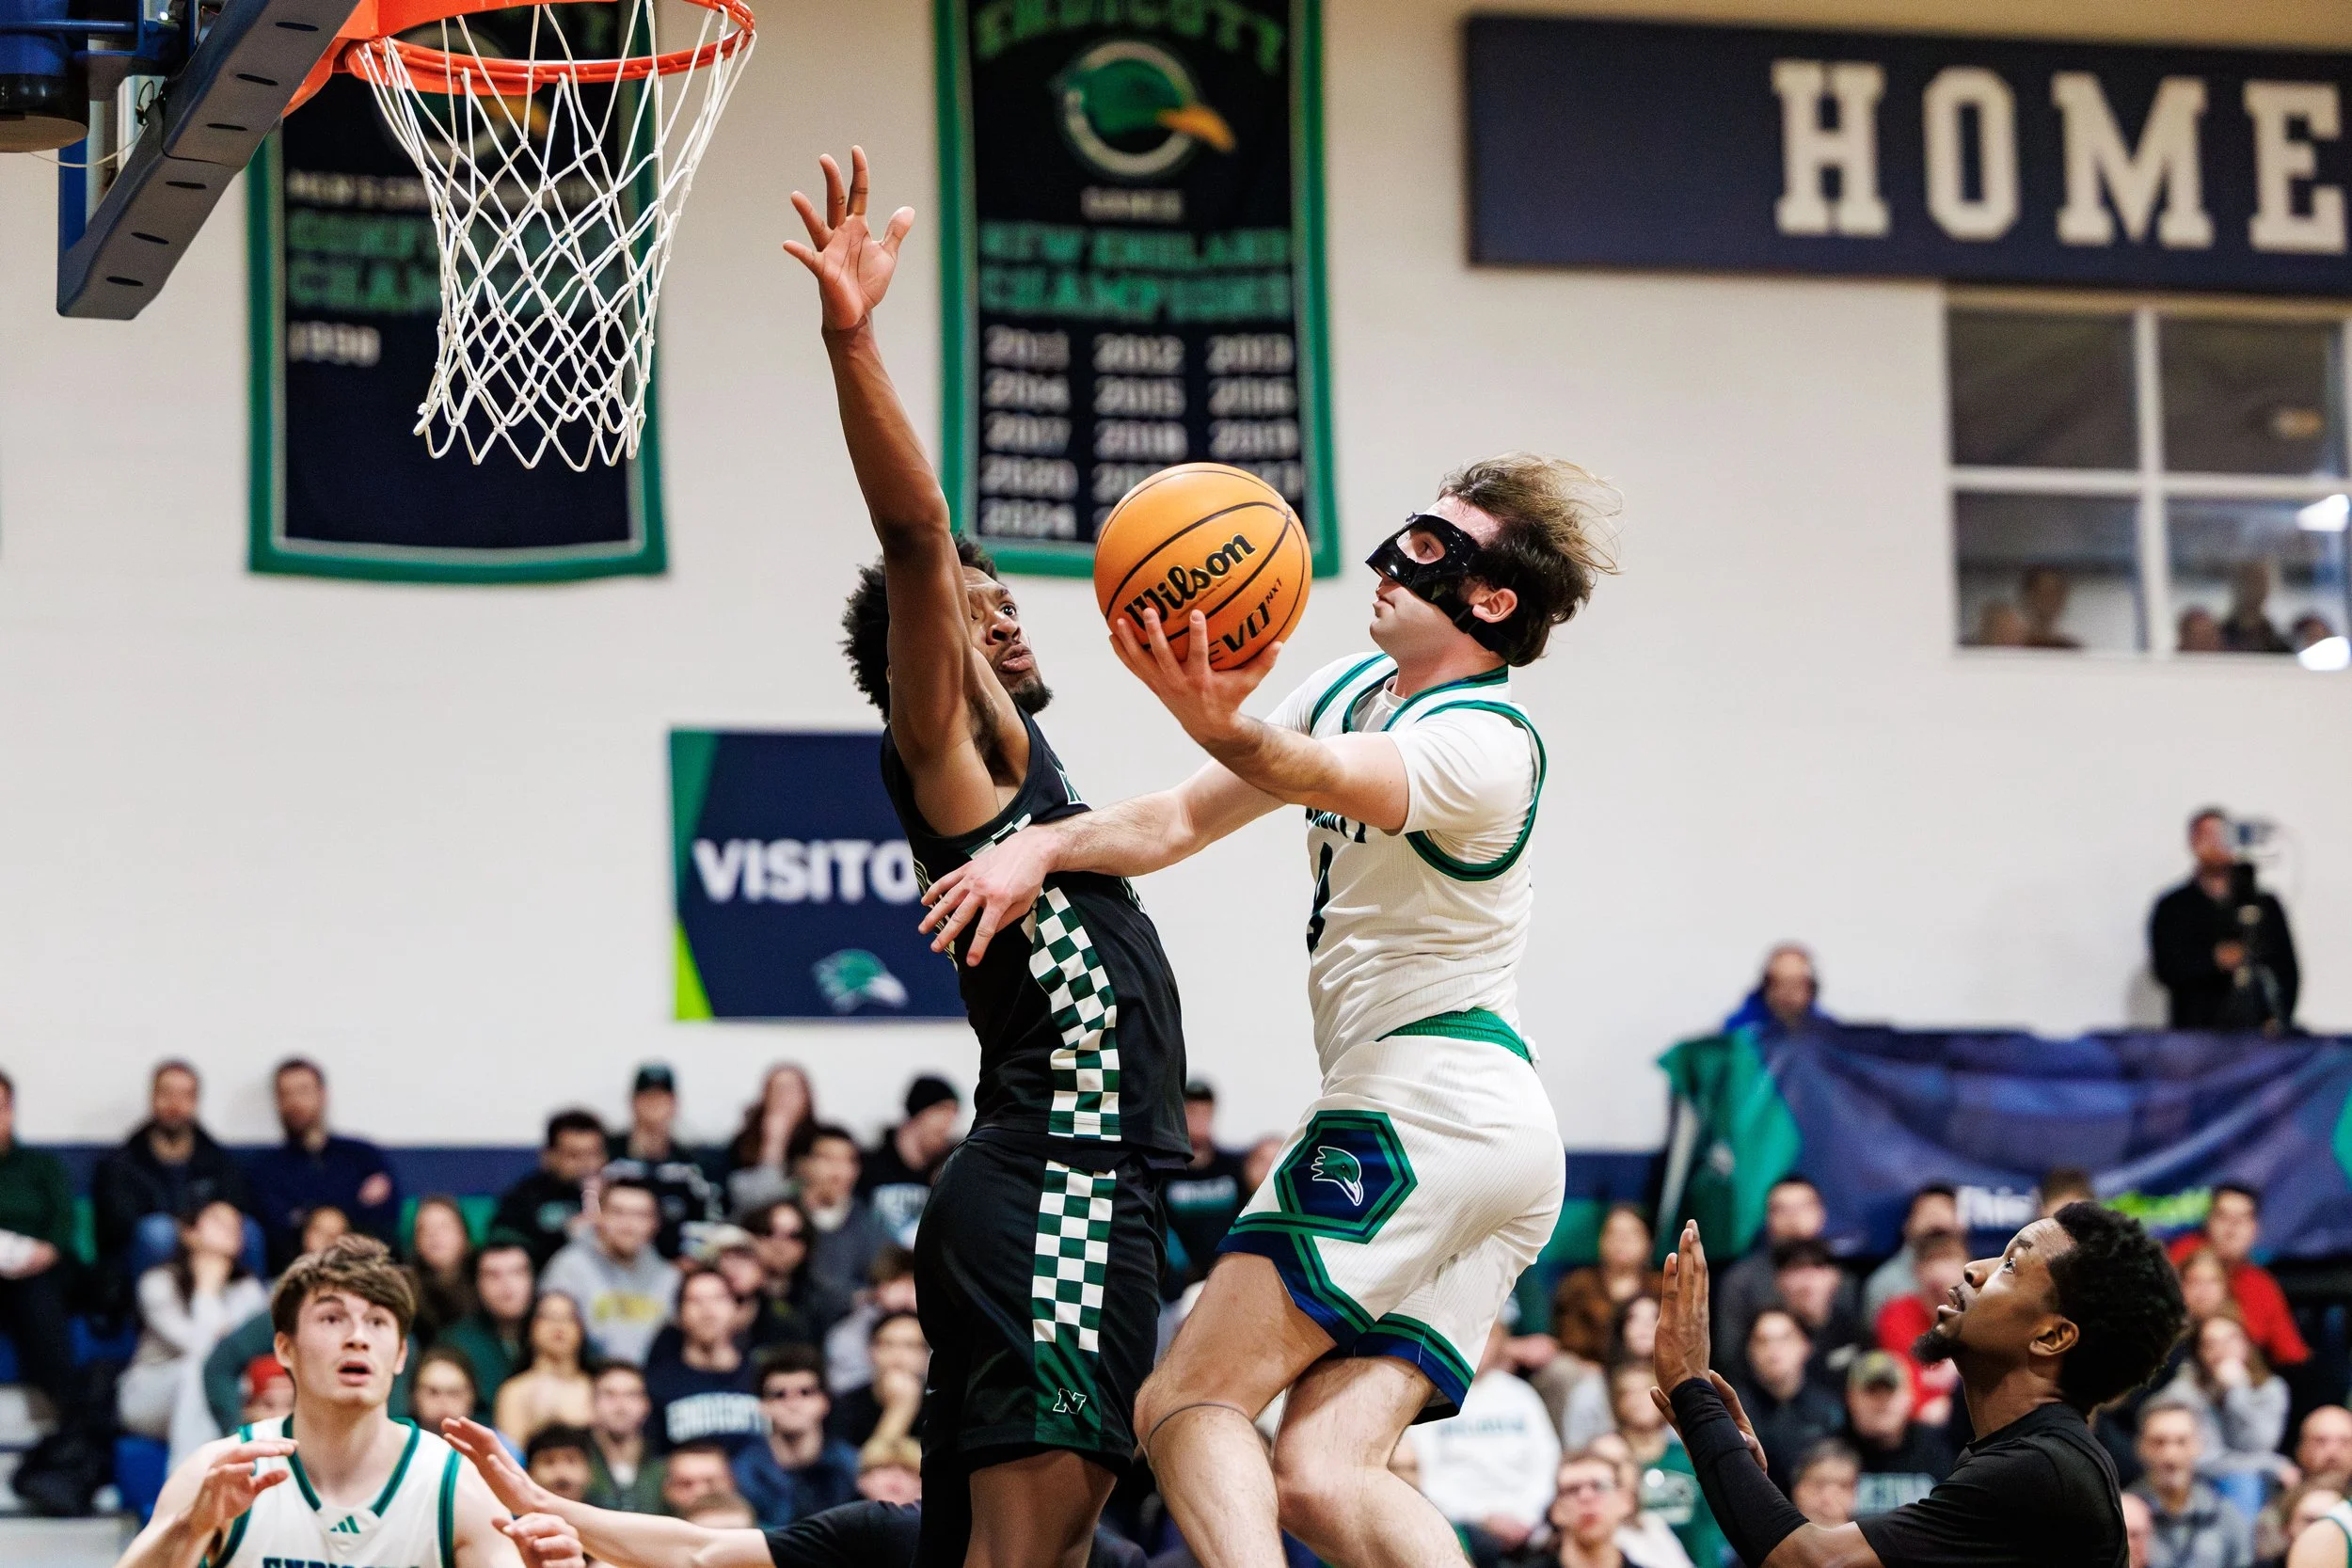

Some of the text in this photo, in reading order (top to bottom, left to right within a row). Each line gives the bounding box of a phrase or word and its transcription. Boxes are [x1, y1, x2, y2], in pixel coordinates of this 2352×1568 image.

[1772, 58, 2346, 253] HOME
[1124, 533, 1256, 632] Wilson
[1209, 602, 1270, 664] EVO
[692, 838, 919, 904] VISITO
[1053, 1387, 1088, 1415] N
